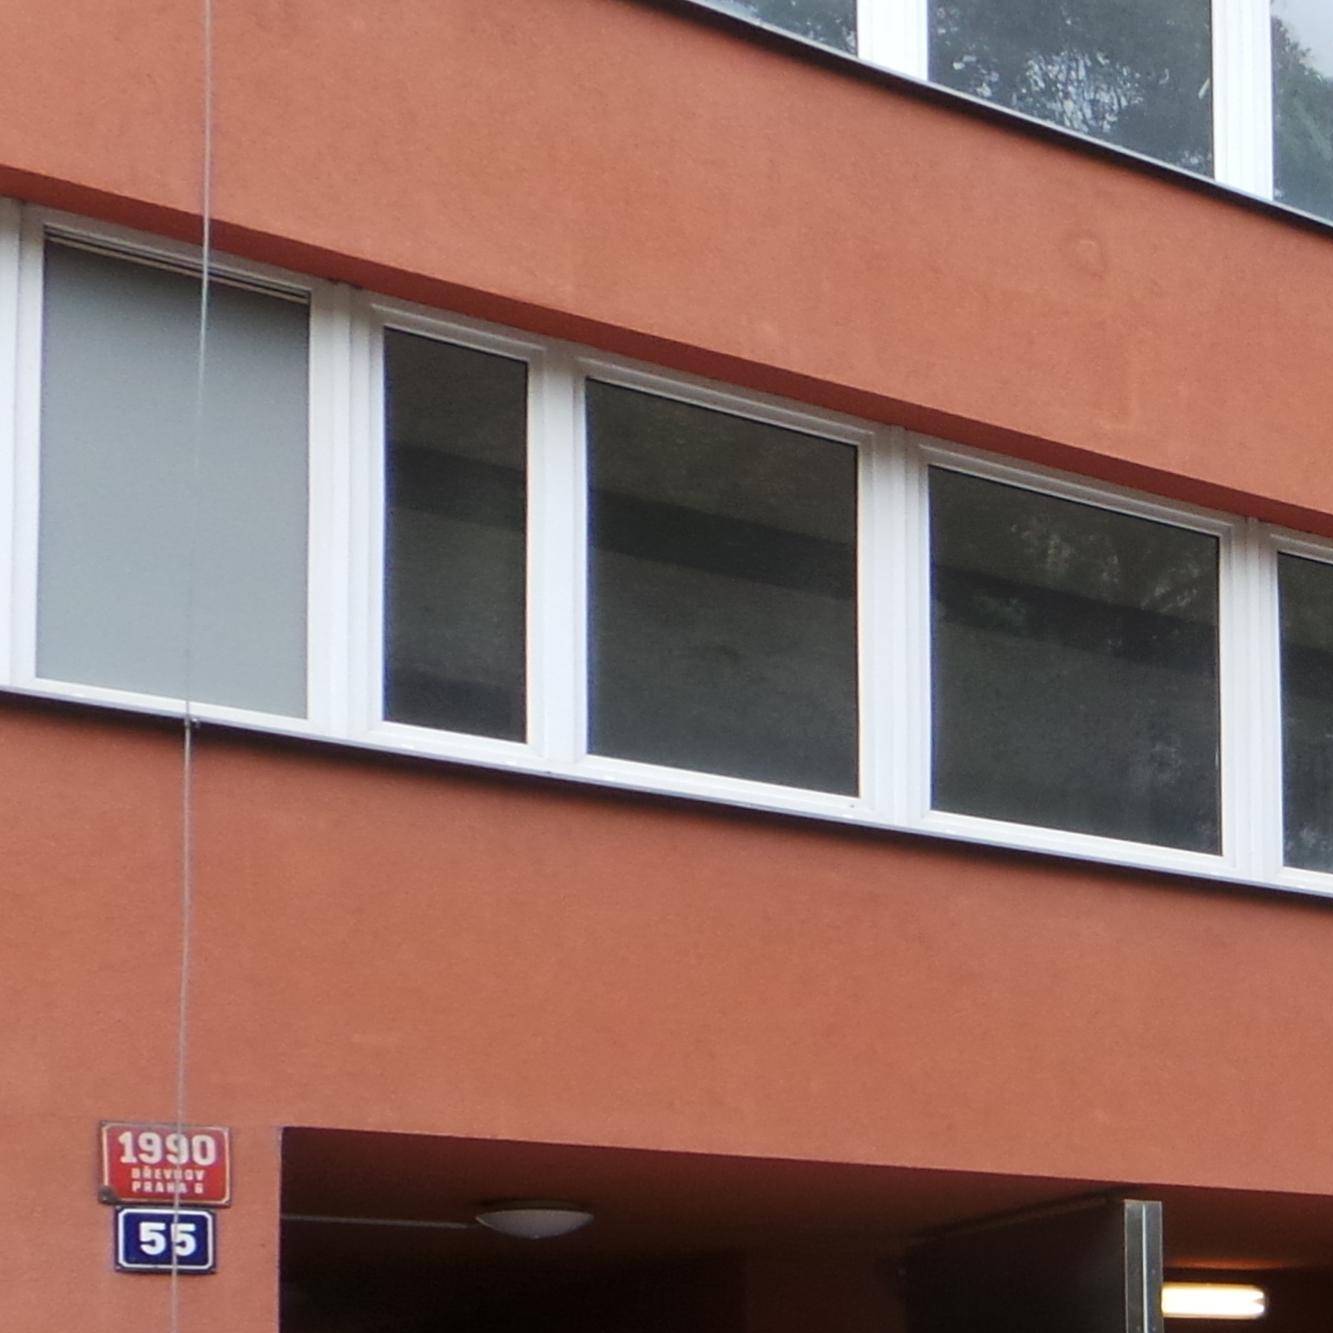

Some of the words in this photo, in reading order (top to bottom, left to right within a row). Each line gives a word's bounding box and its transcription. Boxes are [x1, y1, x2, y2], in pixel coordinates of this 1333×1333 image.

[118, 1131, 216, 1165] 1990
[132, 1181, 188, 1194] PRAHA
[139, 1222, 197, 1256] 55
